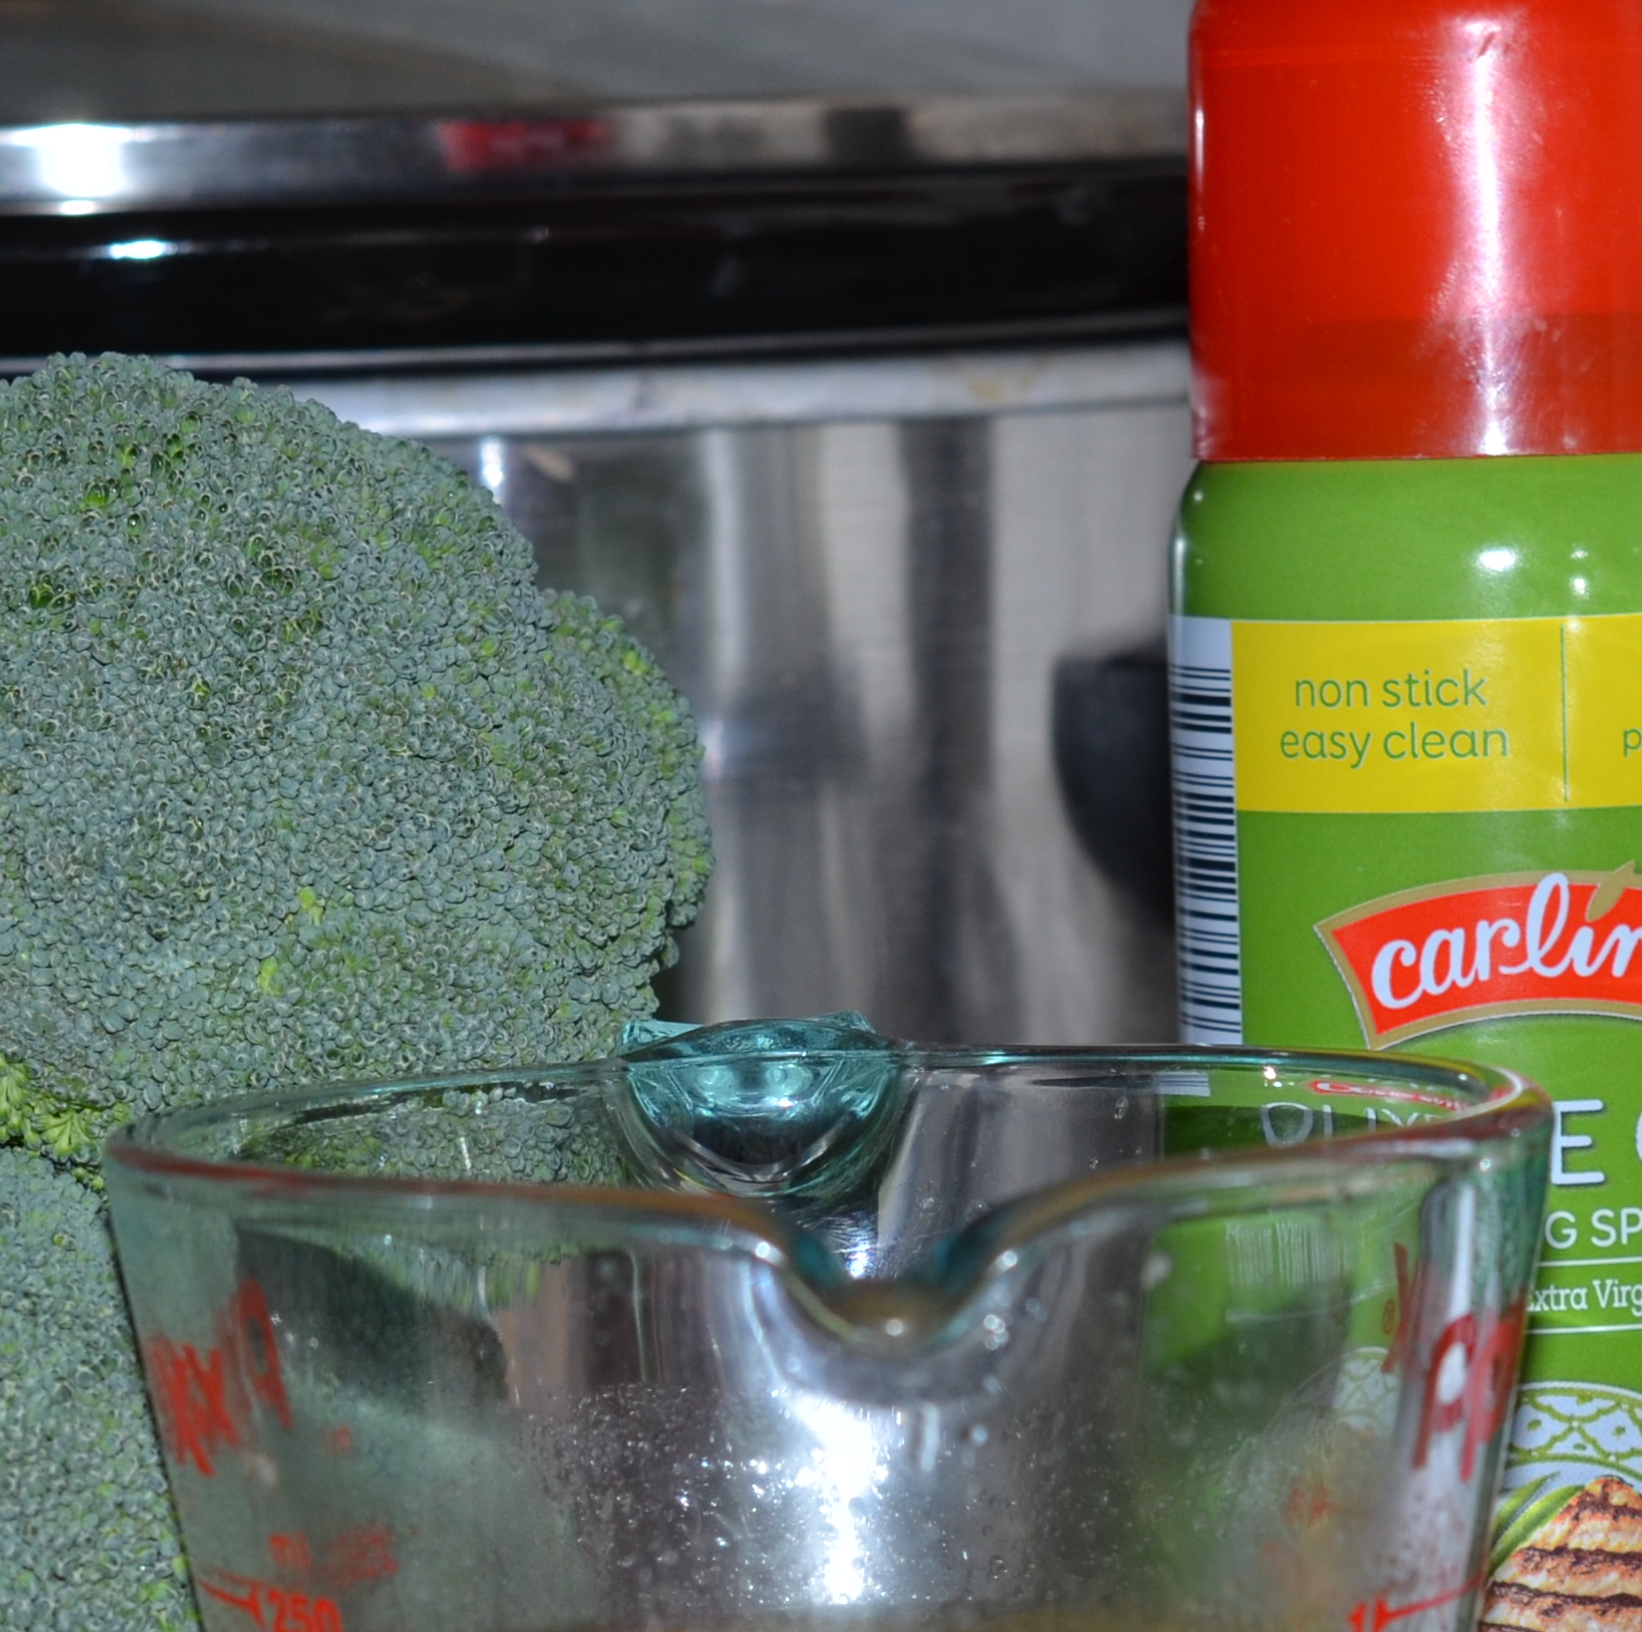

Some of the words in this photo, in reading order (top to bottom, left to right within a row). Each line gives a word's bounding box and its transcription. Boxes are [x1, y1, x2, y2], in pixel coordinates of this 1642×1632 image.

[1294, 677, 1369, 709] non
[1382, 668, 1488, 709] stick
[1279, 728, 1373, 769] easy
[1382, 721, 1510, 761] clean
